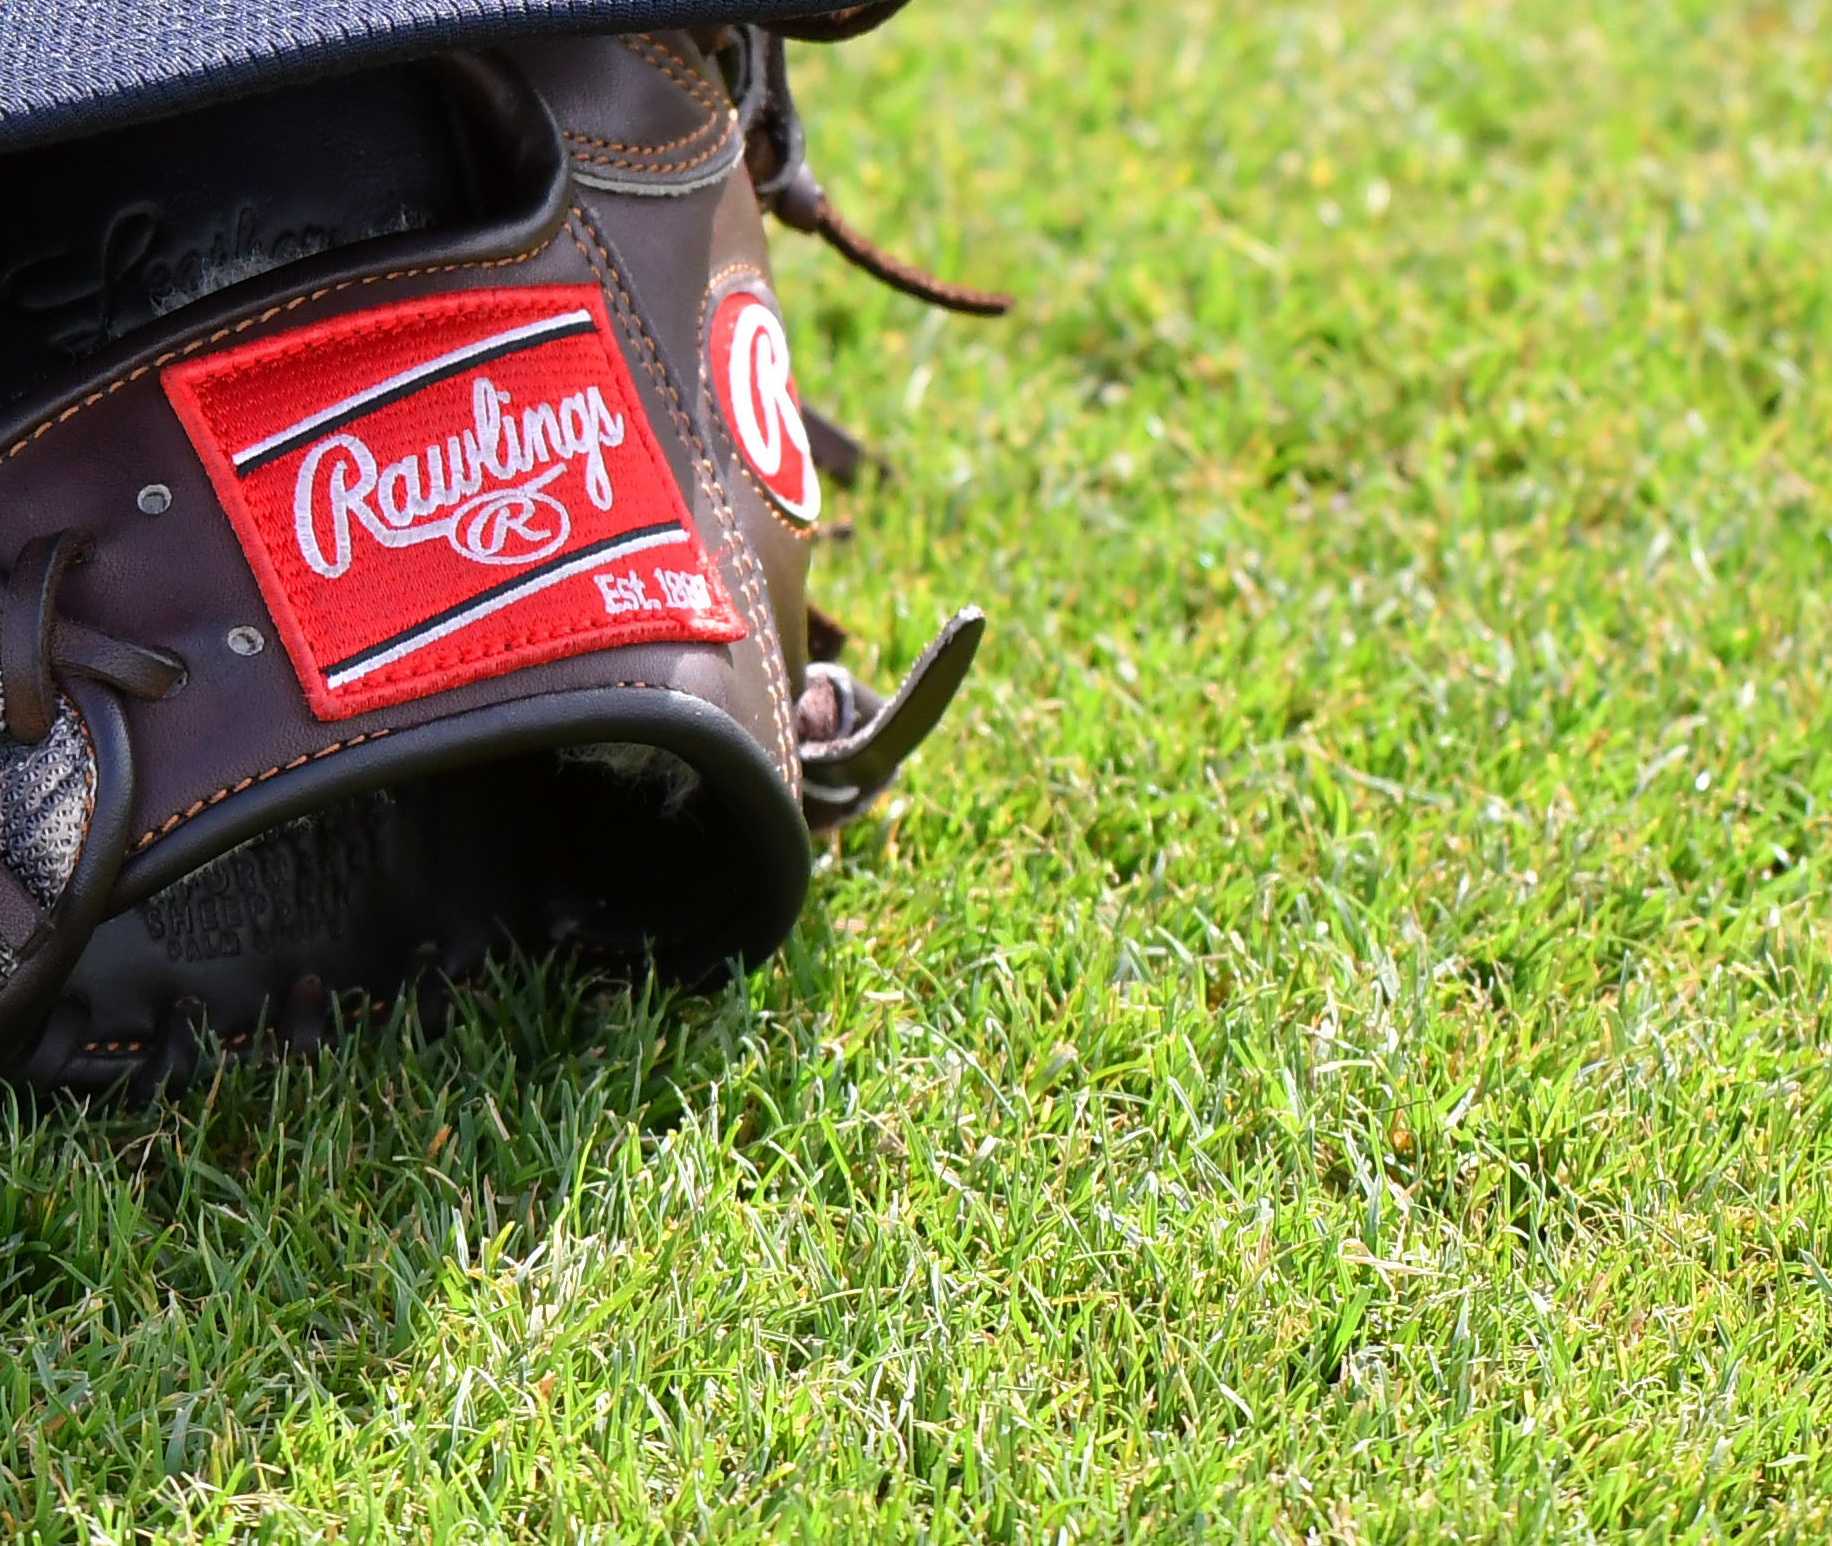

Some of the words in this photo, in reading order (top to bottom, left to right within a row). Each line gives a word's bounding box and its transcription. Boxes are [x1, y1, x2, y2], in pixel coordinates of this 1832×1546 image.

[294, 377, 625, 579] Rawlings
[728, 303, 821, 521] R
[593, 569, 662, 614] Est.
